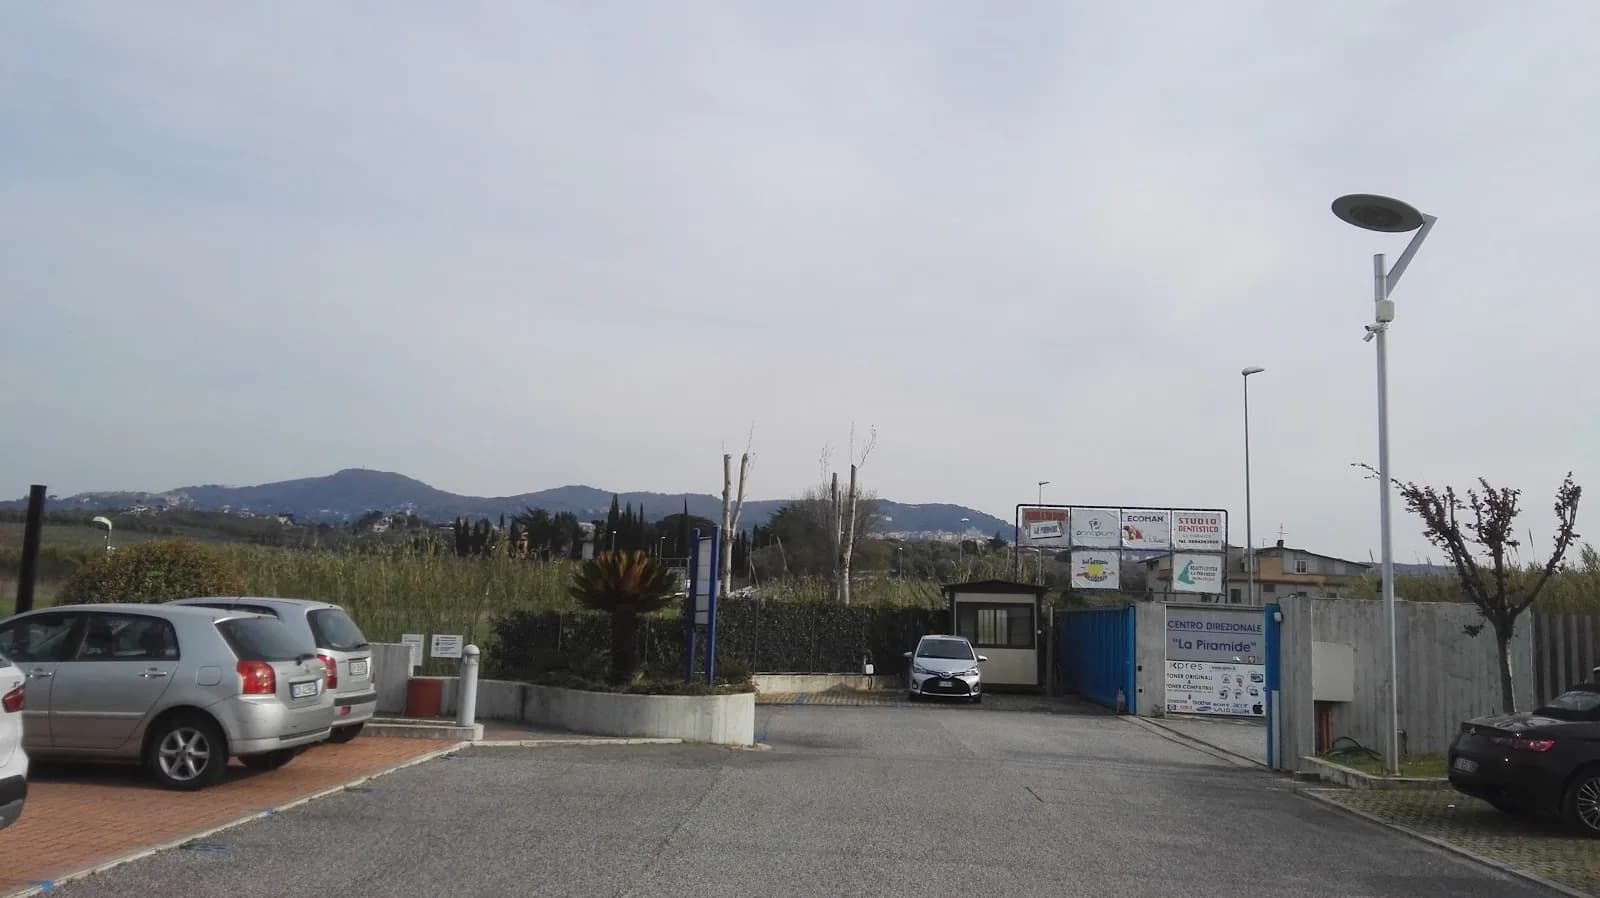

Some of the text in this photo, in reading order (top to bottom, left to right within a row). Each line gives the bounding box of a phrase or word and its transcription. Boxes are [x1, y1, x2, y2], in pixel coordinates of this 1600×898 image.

[1178, 517, 1217, 525] STUDIO
[1178, 525, 1219, 533] DENTISTICO
[1167, 620, 1263, 632] CENTRO DIREZIONALE
